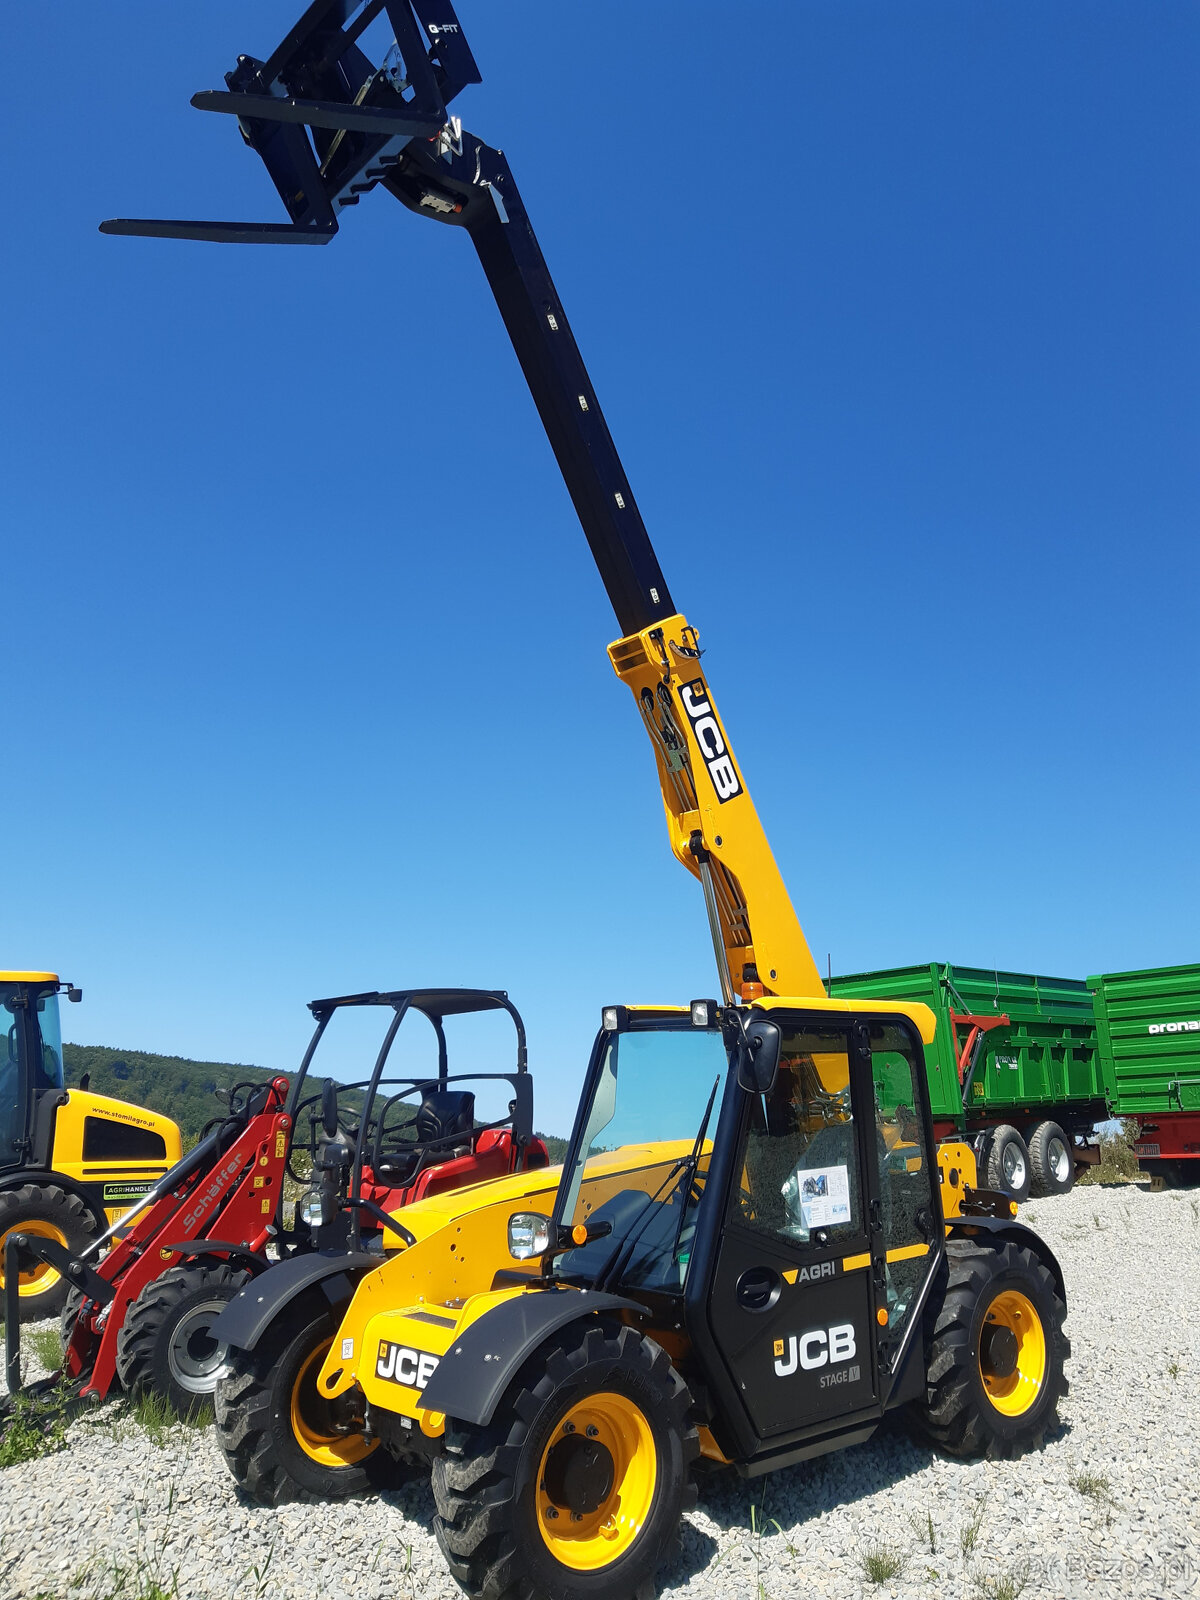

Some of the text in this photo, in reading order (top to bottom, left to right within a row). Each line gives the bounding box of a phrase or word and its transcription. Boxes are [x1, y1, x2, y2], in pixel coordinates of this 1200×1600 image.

[682, 686, 739, 799] JCB
[1148, 1021, 1200, 1034] prona
[92, 1107, 155, 1127] www.stomilagro.pl
[183, 1153, 242, 1235] Schäffer
[799, 1261, 835, 1282] AGRI
[774, 1324, 857, 1377] JCB
[820, 1371, 848, 1388] STAGE
